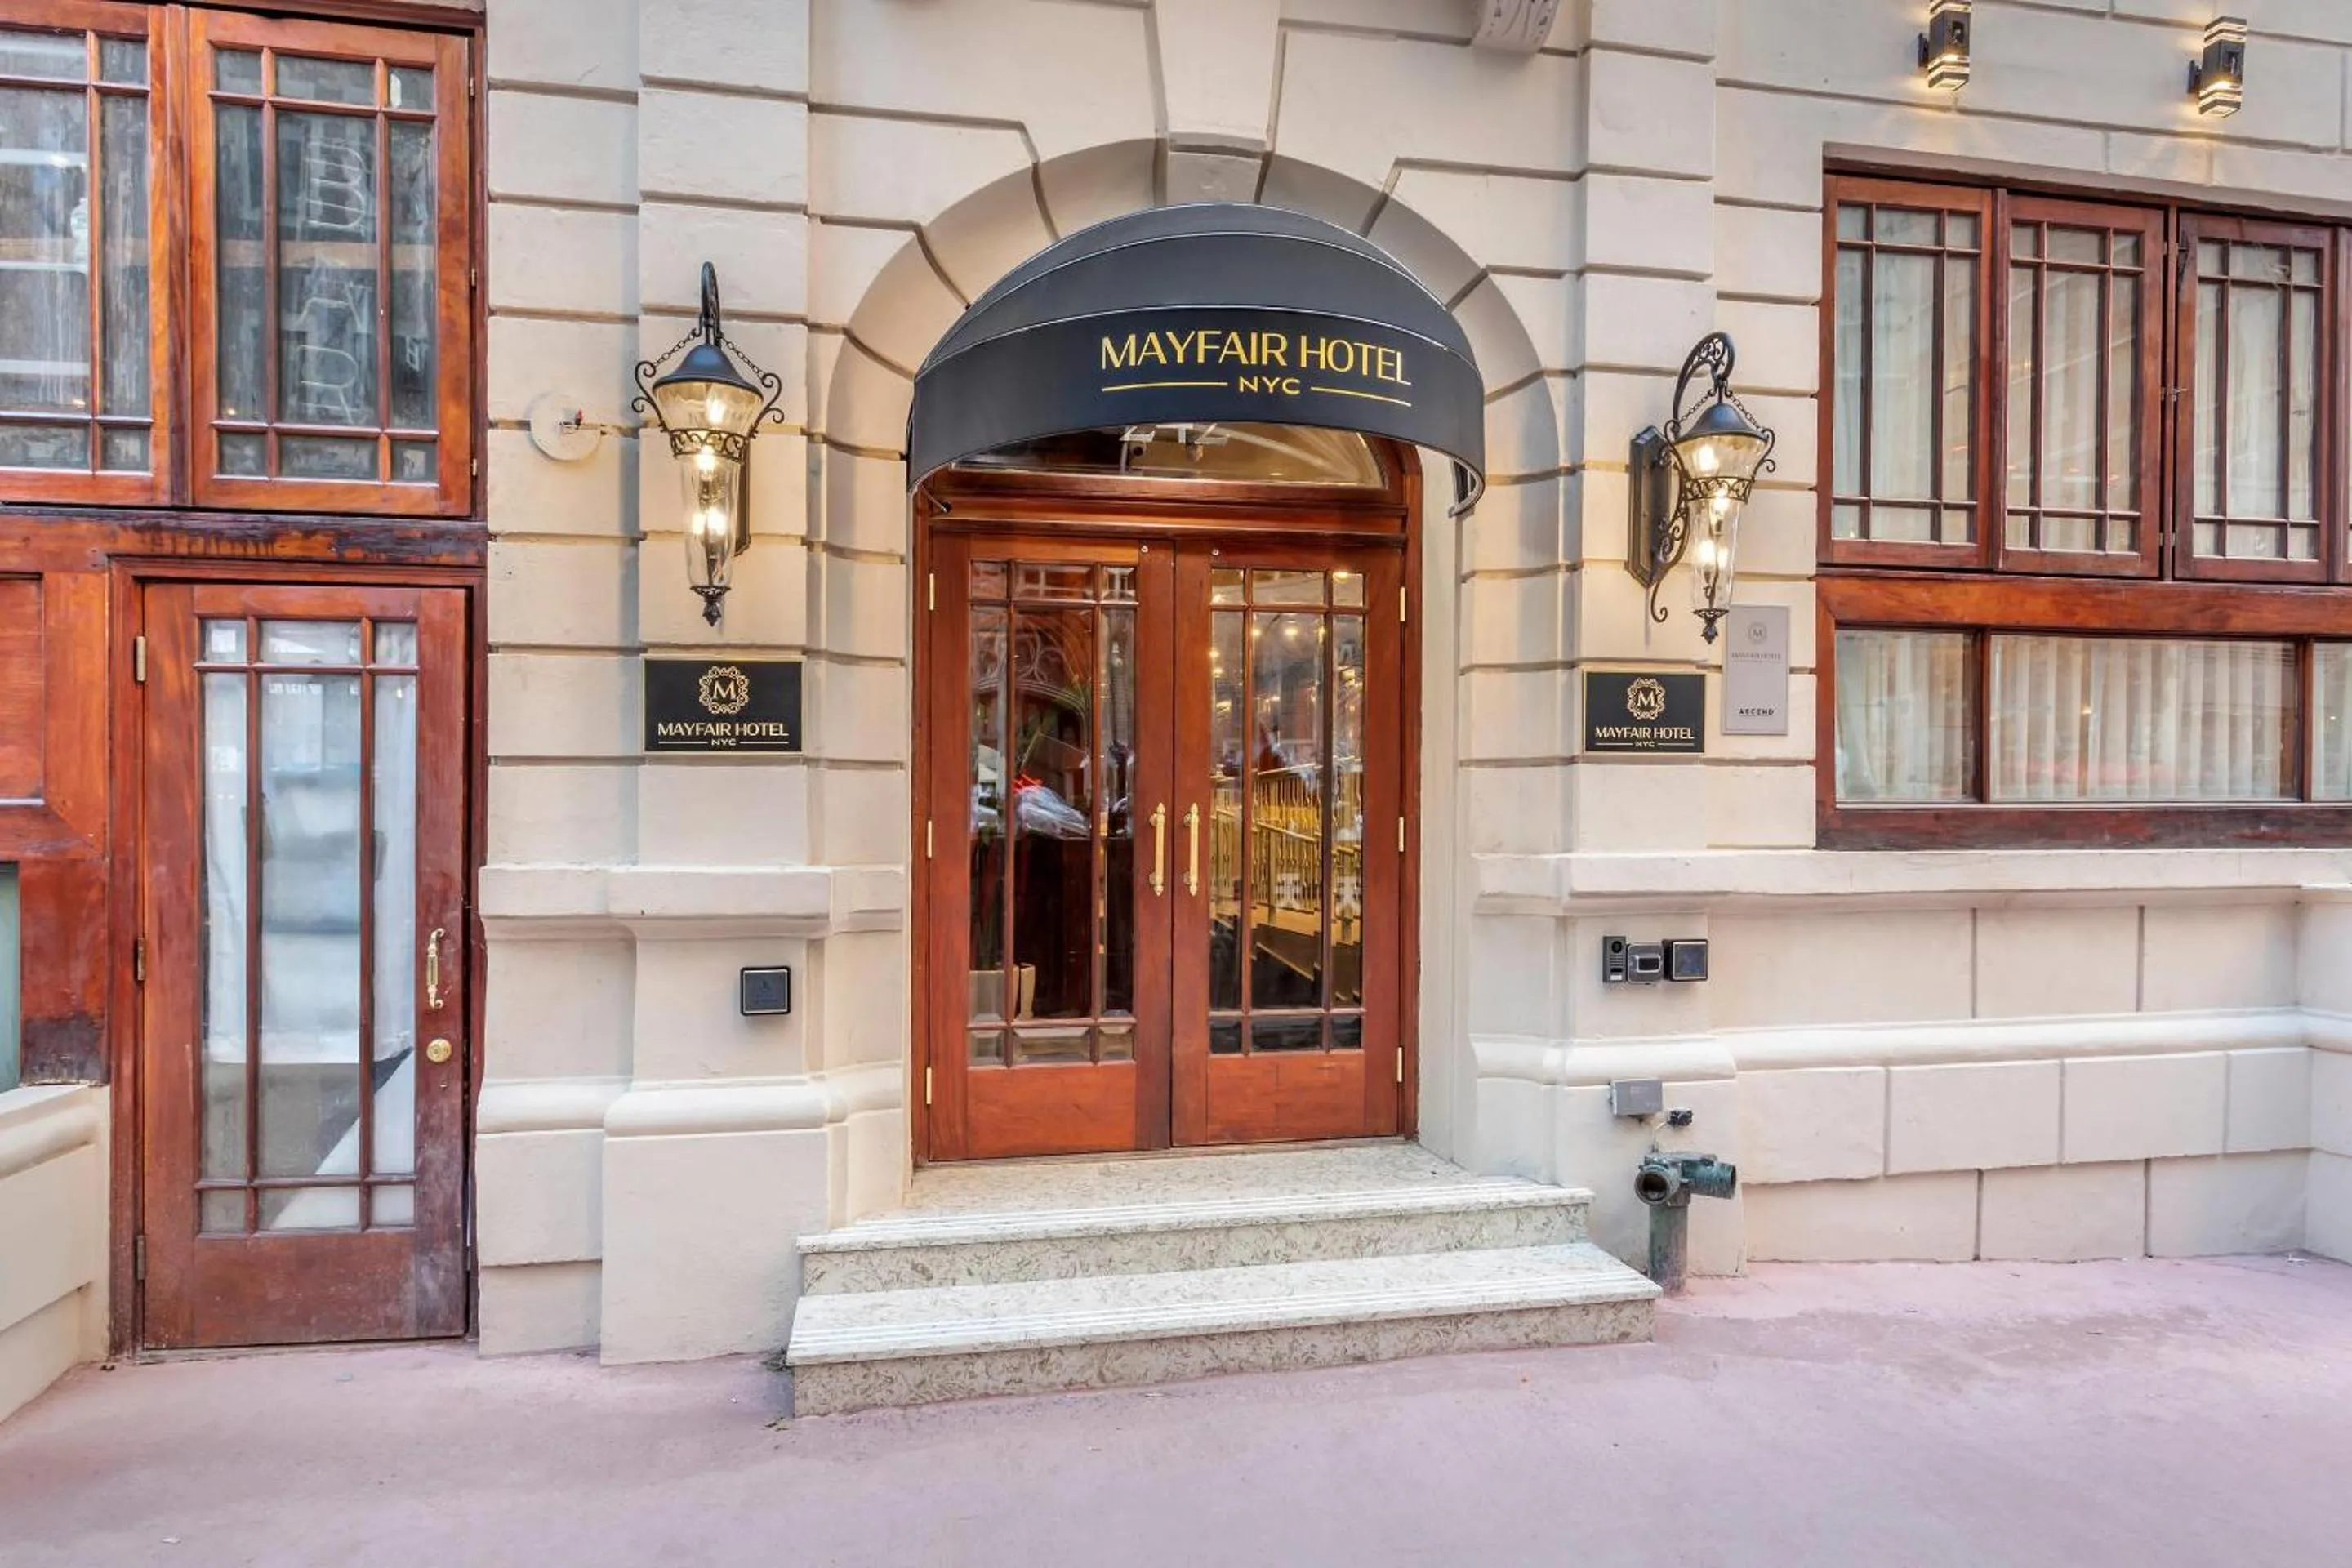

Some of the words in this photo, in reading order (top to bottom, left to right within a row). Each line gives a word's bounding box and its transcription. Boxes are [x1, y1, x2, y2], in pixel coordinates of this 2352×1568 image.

[1102, 330, 1288, 370] MAYFAIR
[1300, 335, 1412, 385] HOTEL
[1238, 376, 1301, 395] NYC
[712, 680, 736, 700] M
[1637, 691, 1655, 706] M
[657, 722, 732, 737] MAYFAIR
[736, 722, 790, 737] HOTEL
[1595, 726, 1652, 739] MAYFAIR
[1653, 726, 1695, 740] HOTEL
